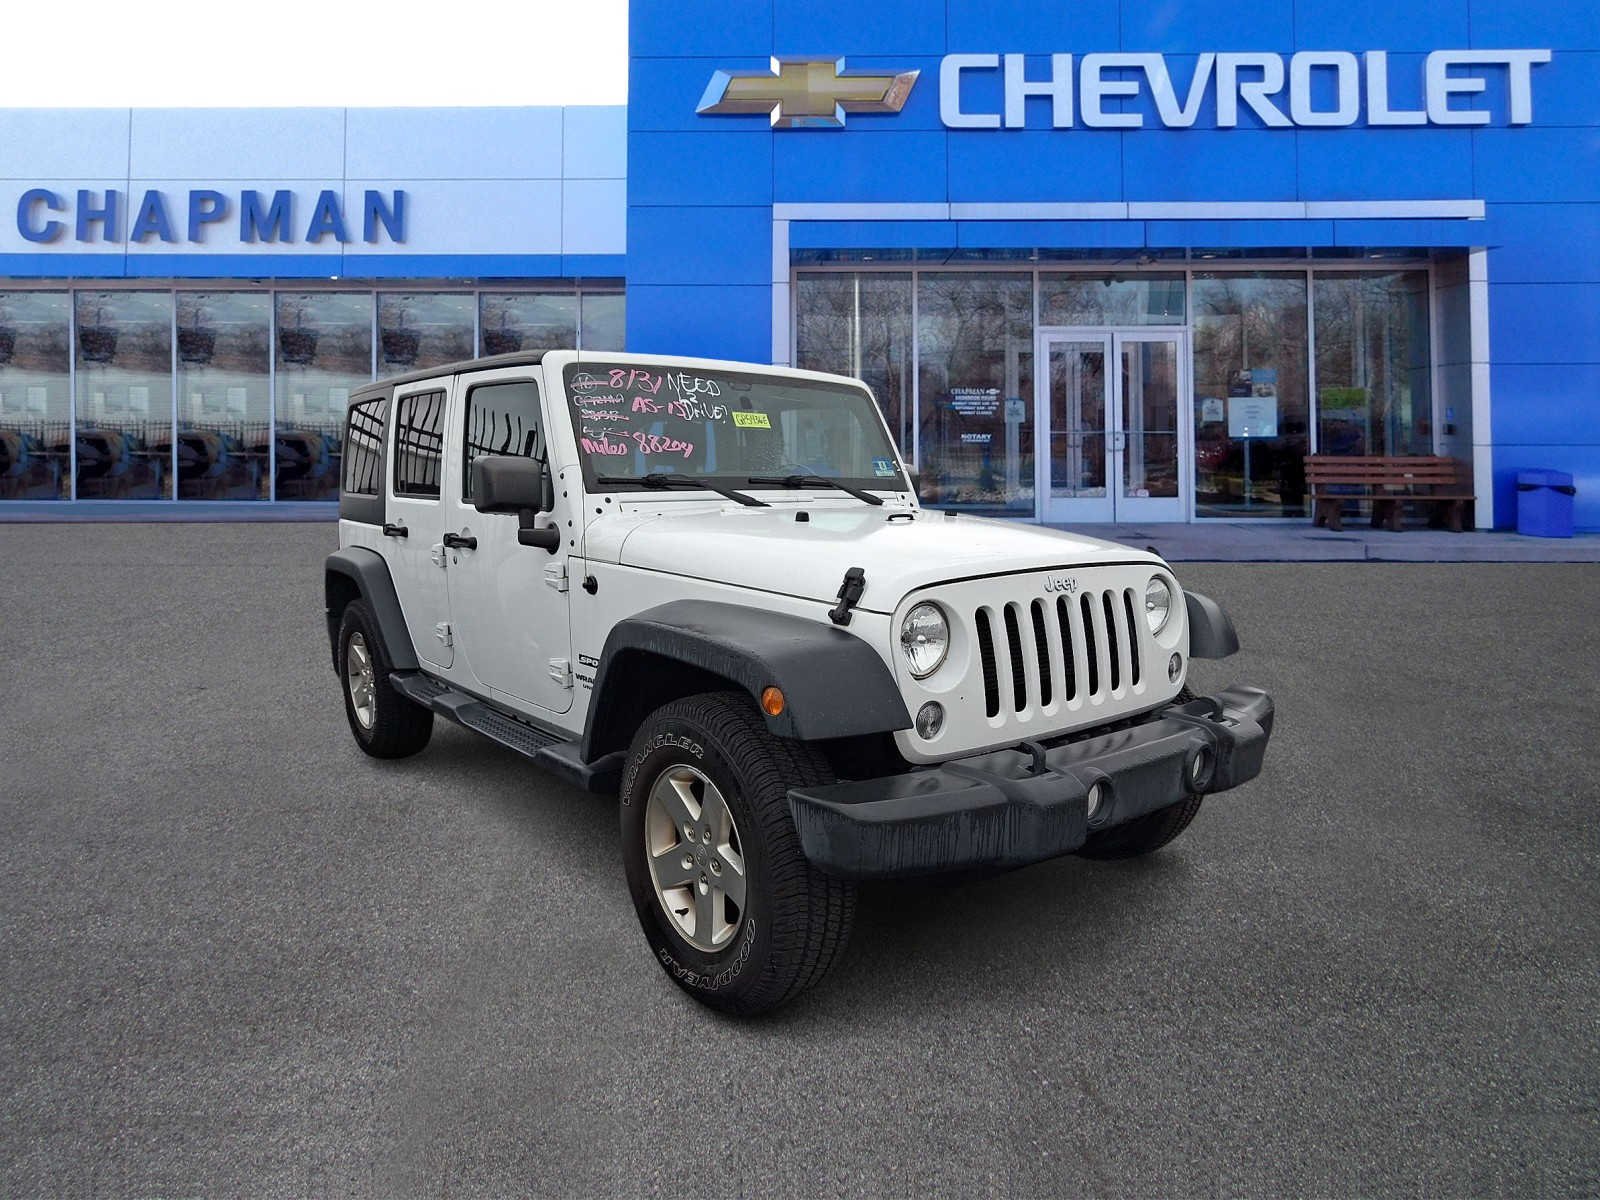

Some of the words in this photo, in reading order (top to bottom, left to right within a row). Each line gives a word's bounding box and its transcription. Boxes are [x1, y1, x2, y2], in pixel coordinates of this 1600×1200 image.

[939, 48, 1552, 129] CHEVROLET
[17, 188, 406, 243] CHAPMAN
[668, 371, 721, 397] NEED
[1044, 575, 1077, 594] Jeep
[575, 673, 594, 684] WRA
[623, 733, 705, 806] WRANGLER
[660, 919, 756, 991] GOODYEAR
